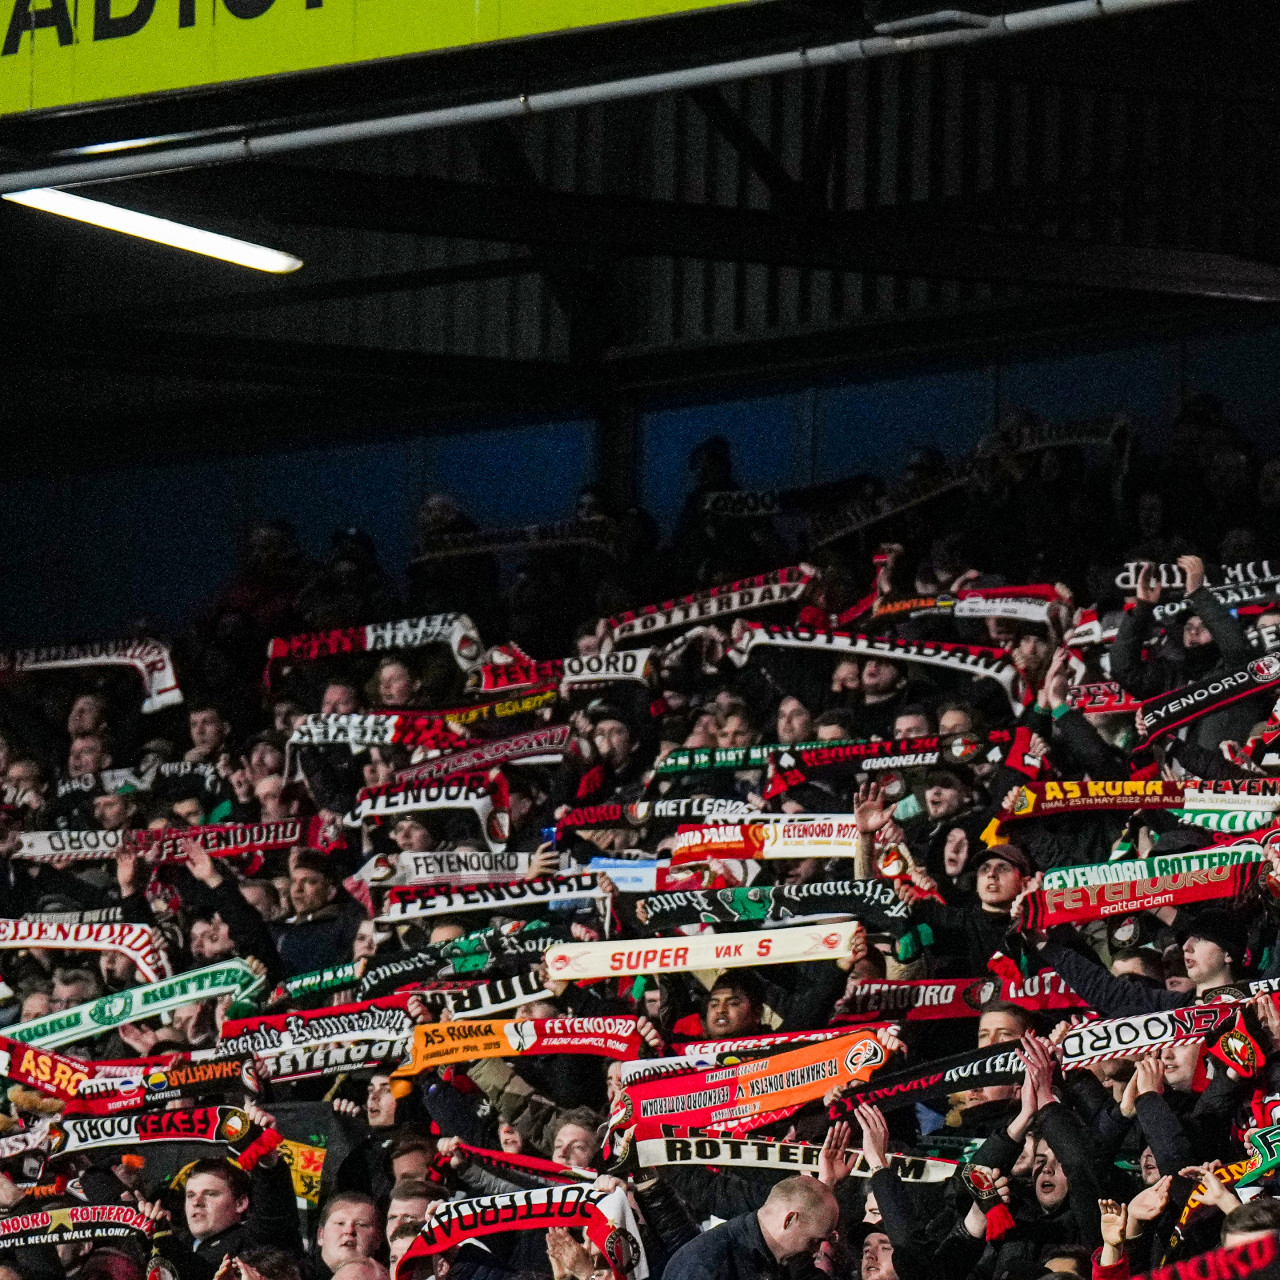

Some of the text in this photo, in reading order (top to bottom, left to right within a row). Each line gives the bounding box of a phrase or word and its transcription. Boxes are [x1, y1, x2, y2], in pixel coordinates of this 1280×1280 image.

[619, 583, 804, 636] ROTTERDAM
[768, 625, 1010, 673] ROTTERDAM
[490, 653, 636, 688] FEYENOORD
[862, 752, 941, 770] FEYENOORD
[1045, 781, 1082, 802] AS
[1089, 778, 1163, 799] ROMA
[1072, 797, 1101, 809] 25TH
[1102, 796, 1121, 807] MAY
[1122, 795, 1146, 806] 2022
[655, 799, 690, 818] HET
[782, 822, 834, 838] FEYENOORD
[414, 854, 518, 873] FEYENOORD
[1042, 861, 1147, 888] FEYENOORD
[398, 872, 598, 913] FEYENOORD
[1047, 865, 1231, 916] FEYENOORD
[1100, 893, 1174, 916] Rotterdam
[610, 937, 774, 972] SUPER VAK S
[286, 1001, 406, 1045] Kameraden
[423, 1022, 496, 1047] AS ROMA
[546, 1017, 636, 1038] FEYENOORD
[541, 1038, 570, 1047] STADIO
[606, 1041, 629, 1052] ROME
[20, 1050, 52, 1077] AS
[166, 1061, 242, 1087] SHAKHTAR
[641, 1059, 838, 1118] FC SHAKHTAR DONETSK V FEYENOORD ROTTERDAM
[75, 1110, 210, 1142] FEYENOORD
[26, 1225, 133, 1247] NEVER WALK ALONE!
